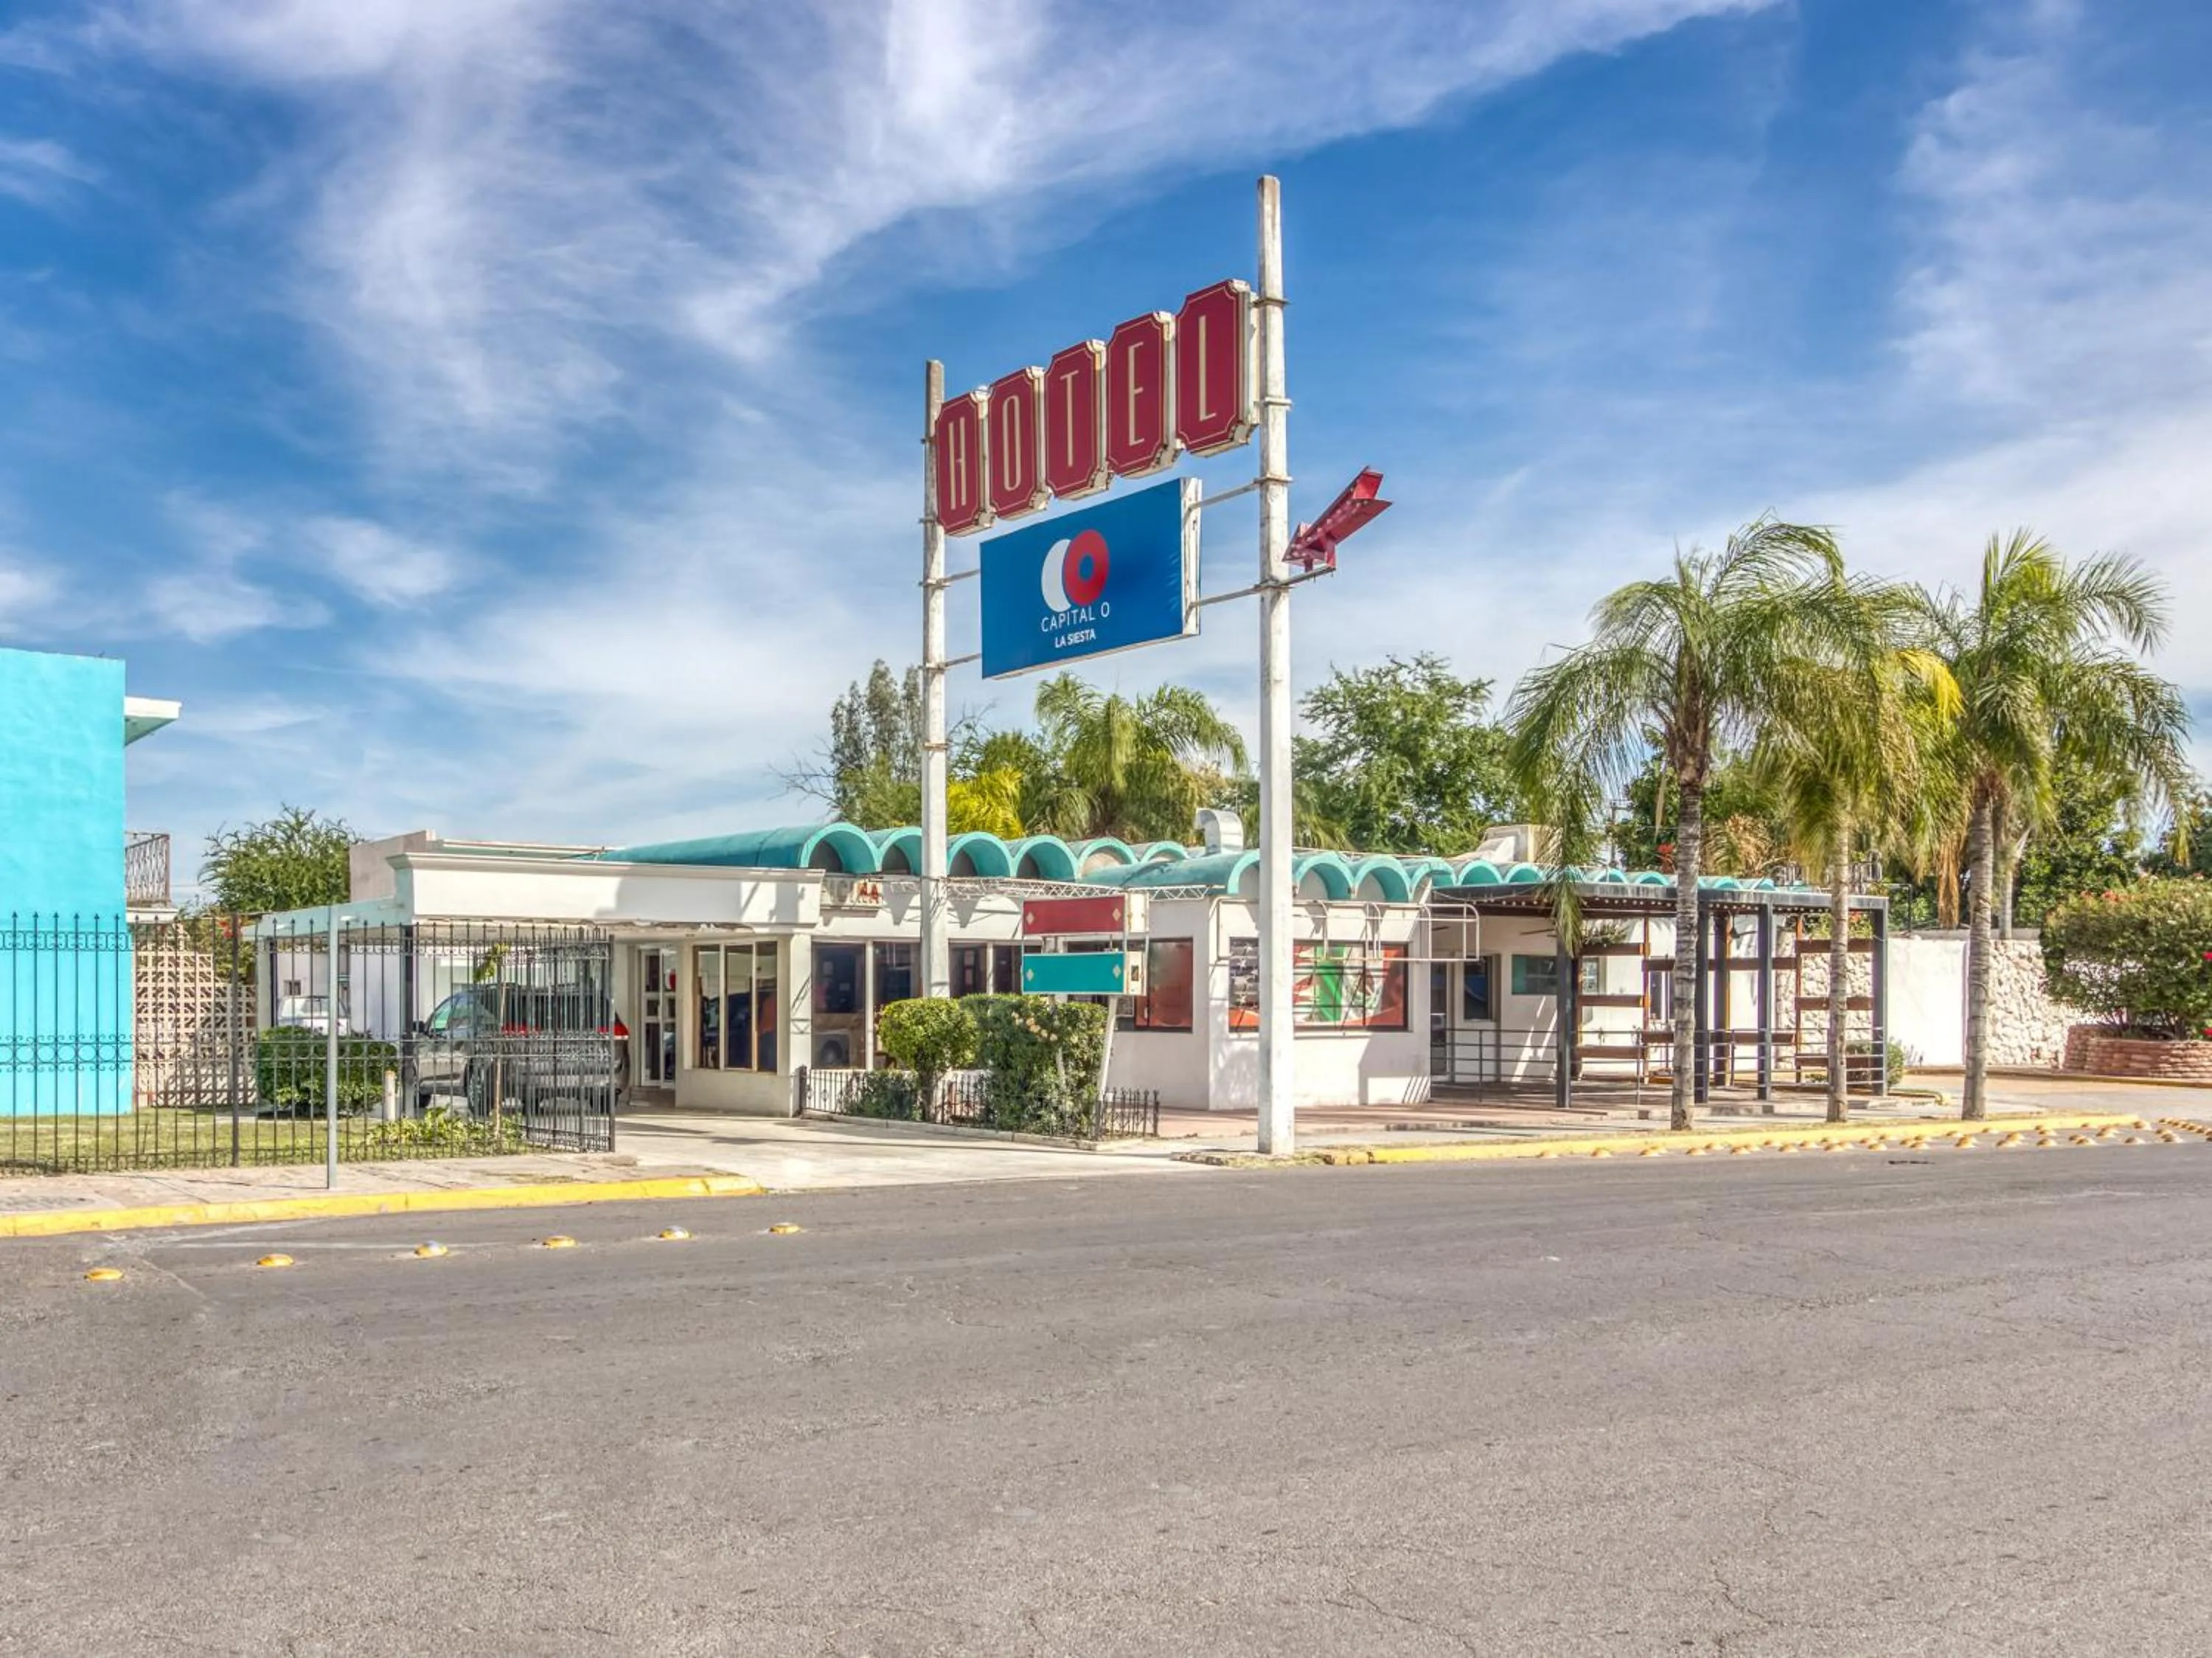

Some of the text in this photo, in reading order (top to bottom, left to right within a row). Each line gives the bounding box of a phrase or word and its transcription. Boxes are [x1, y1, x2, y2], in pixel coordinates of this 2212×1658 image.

[948, 315, 1216, 510] HOTEL
[1041, 601, 1110, 632] CAPITAL O
[1054, 635, 1066, 648] LA
